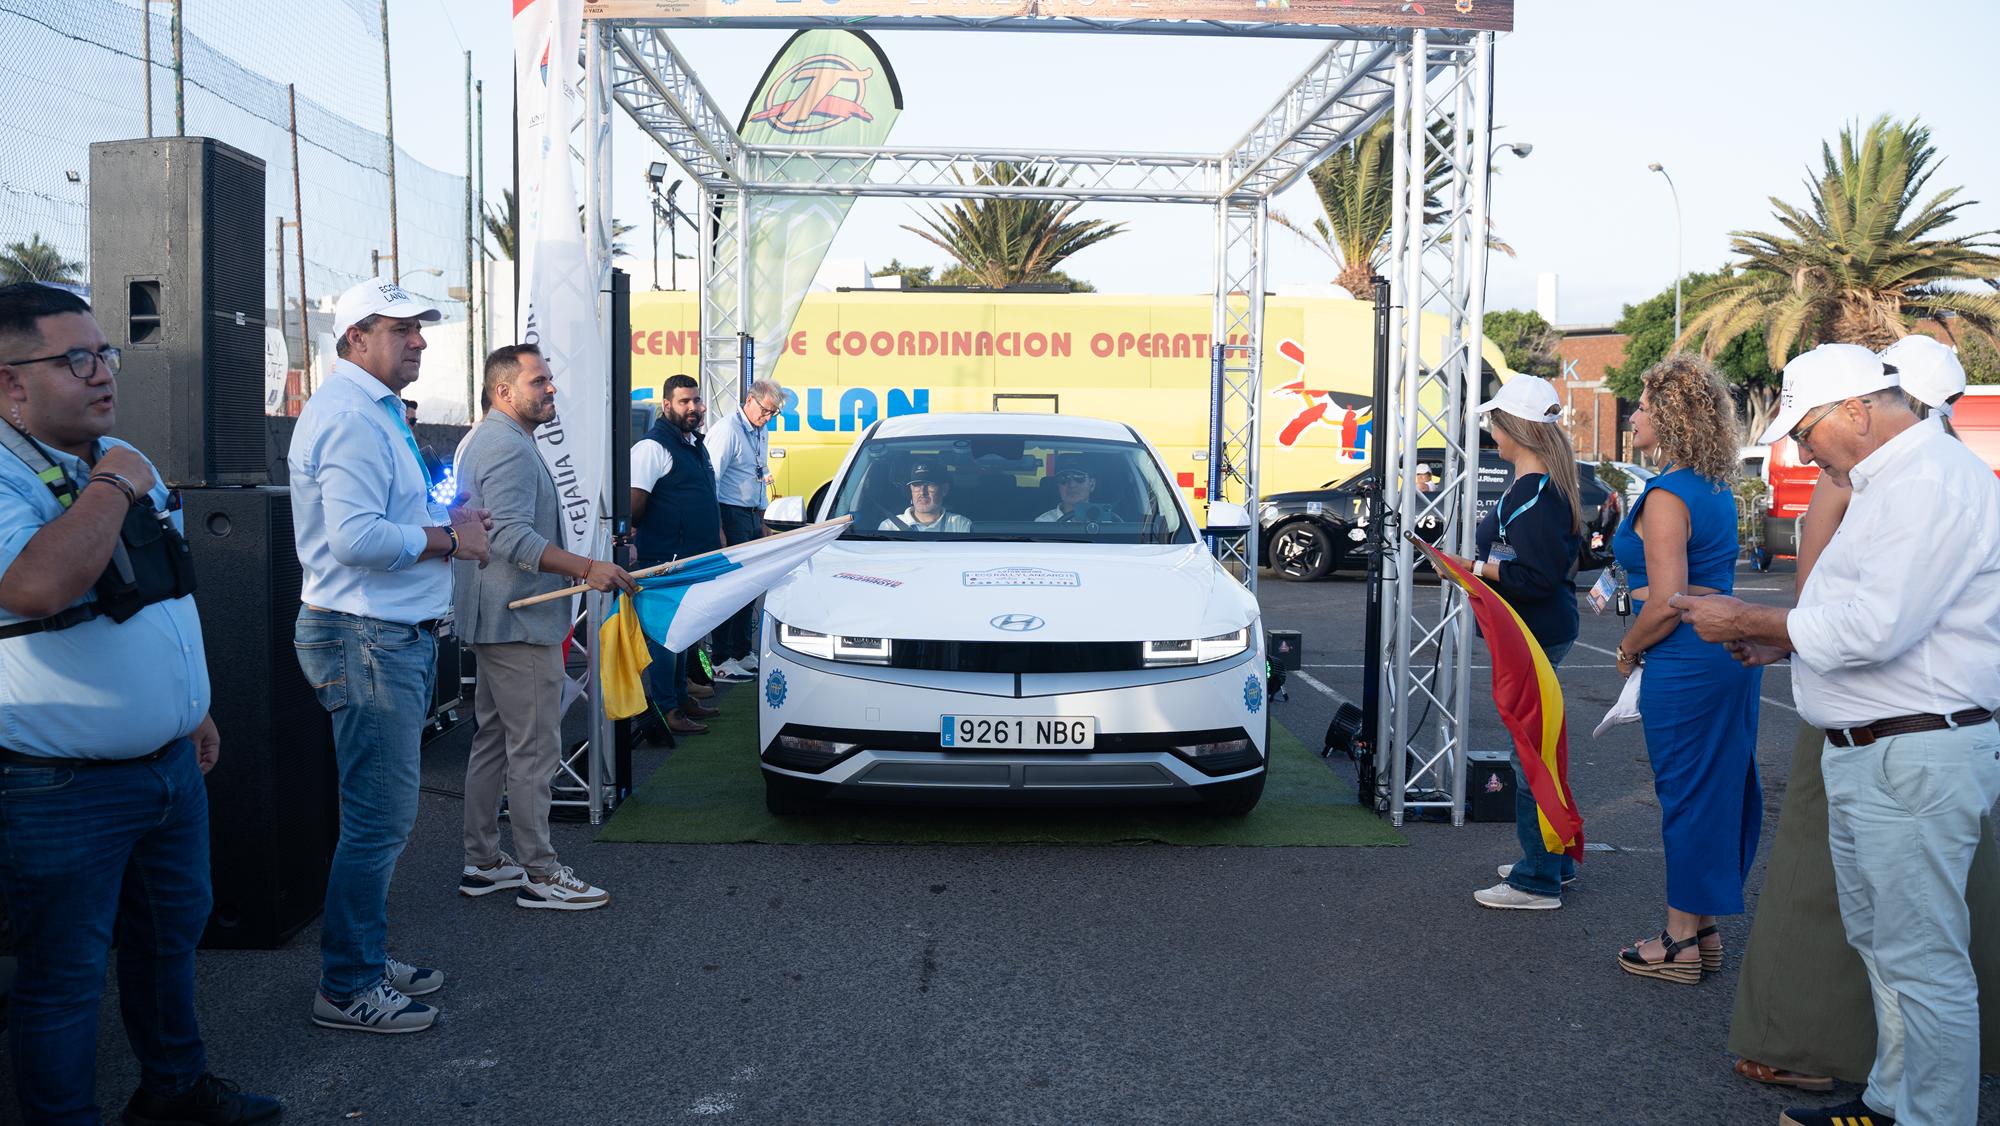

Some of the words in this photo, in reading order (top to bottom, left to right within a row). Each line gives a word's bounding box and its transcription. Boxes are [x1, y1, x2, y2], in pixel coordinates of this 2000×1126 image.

[631, 331, 701, 356] CENT
[825, 331, 1072, 358] COORDINACION
[1352, 499, 1362, 514] 7
[960, 719, 1024, 744] 9261
[1036, 720, 1087, 745] NBG
